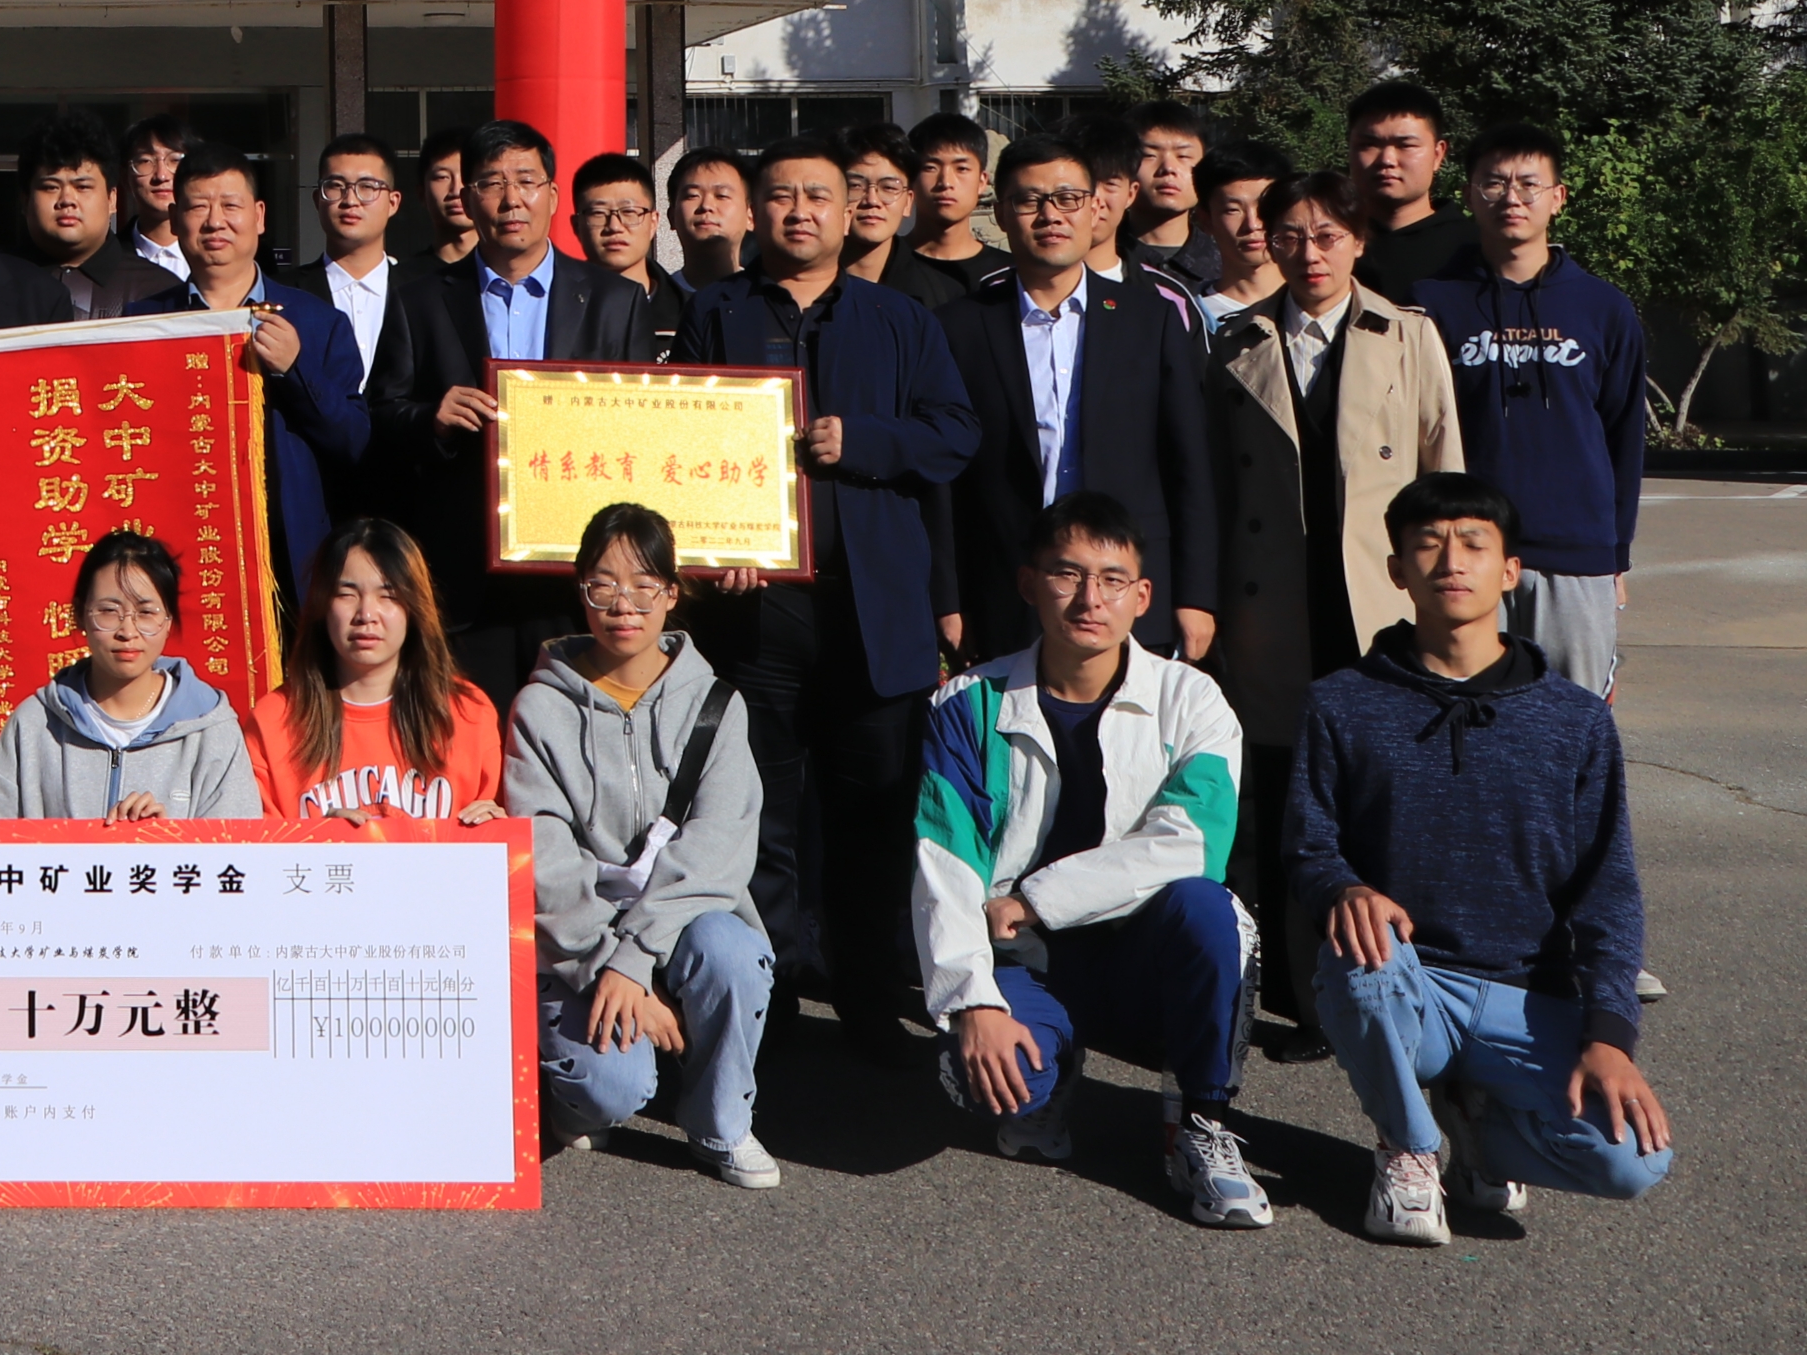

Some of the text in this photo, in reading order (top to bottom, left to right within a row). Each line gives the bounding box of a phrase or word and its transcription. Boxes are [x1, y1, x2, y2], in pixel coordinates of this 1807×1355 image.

[29, 377, 93, 564] 捐资助学
[528, 450, 769, 487] 情系教育 爱心助学
[299, 765, 453, 819] CHICAGO
[282, 863, 355, 894] 支票
[7, 988, 221, 1038] 十万元整
